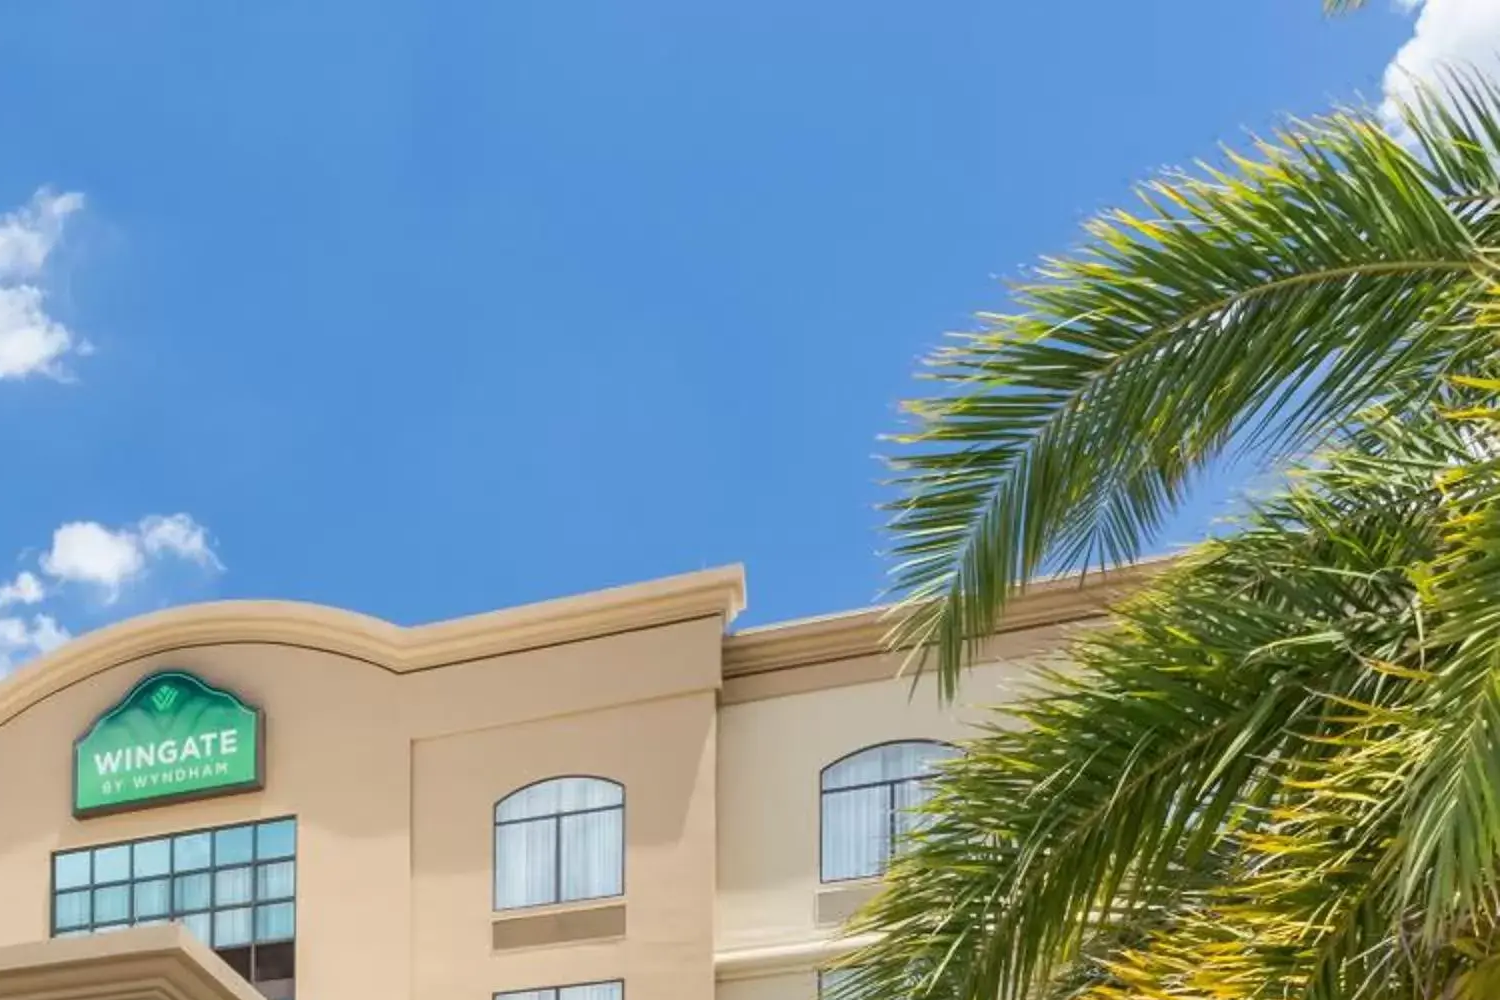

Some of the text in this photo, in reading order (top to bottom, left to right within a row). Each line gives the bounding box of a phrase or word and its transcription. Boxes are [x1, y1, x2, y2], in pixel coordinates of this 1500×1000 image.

[94, 729, 238, 775] WINGATE
[102, 762, 228, 795] BY WYNDHAM
